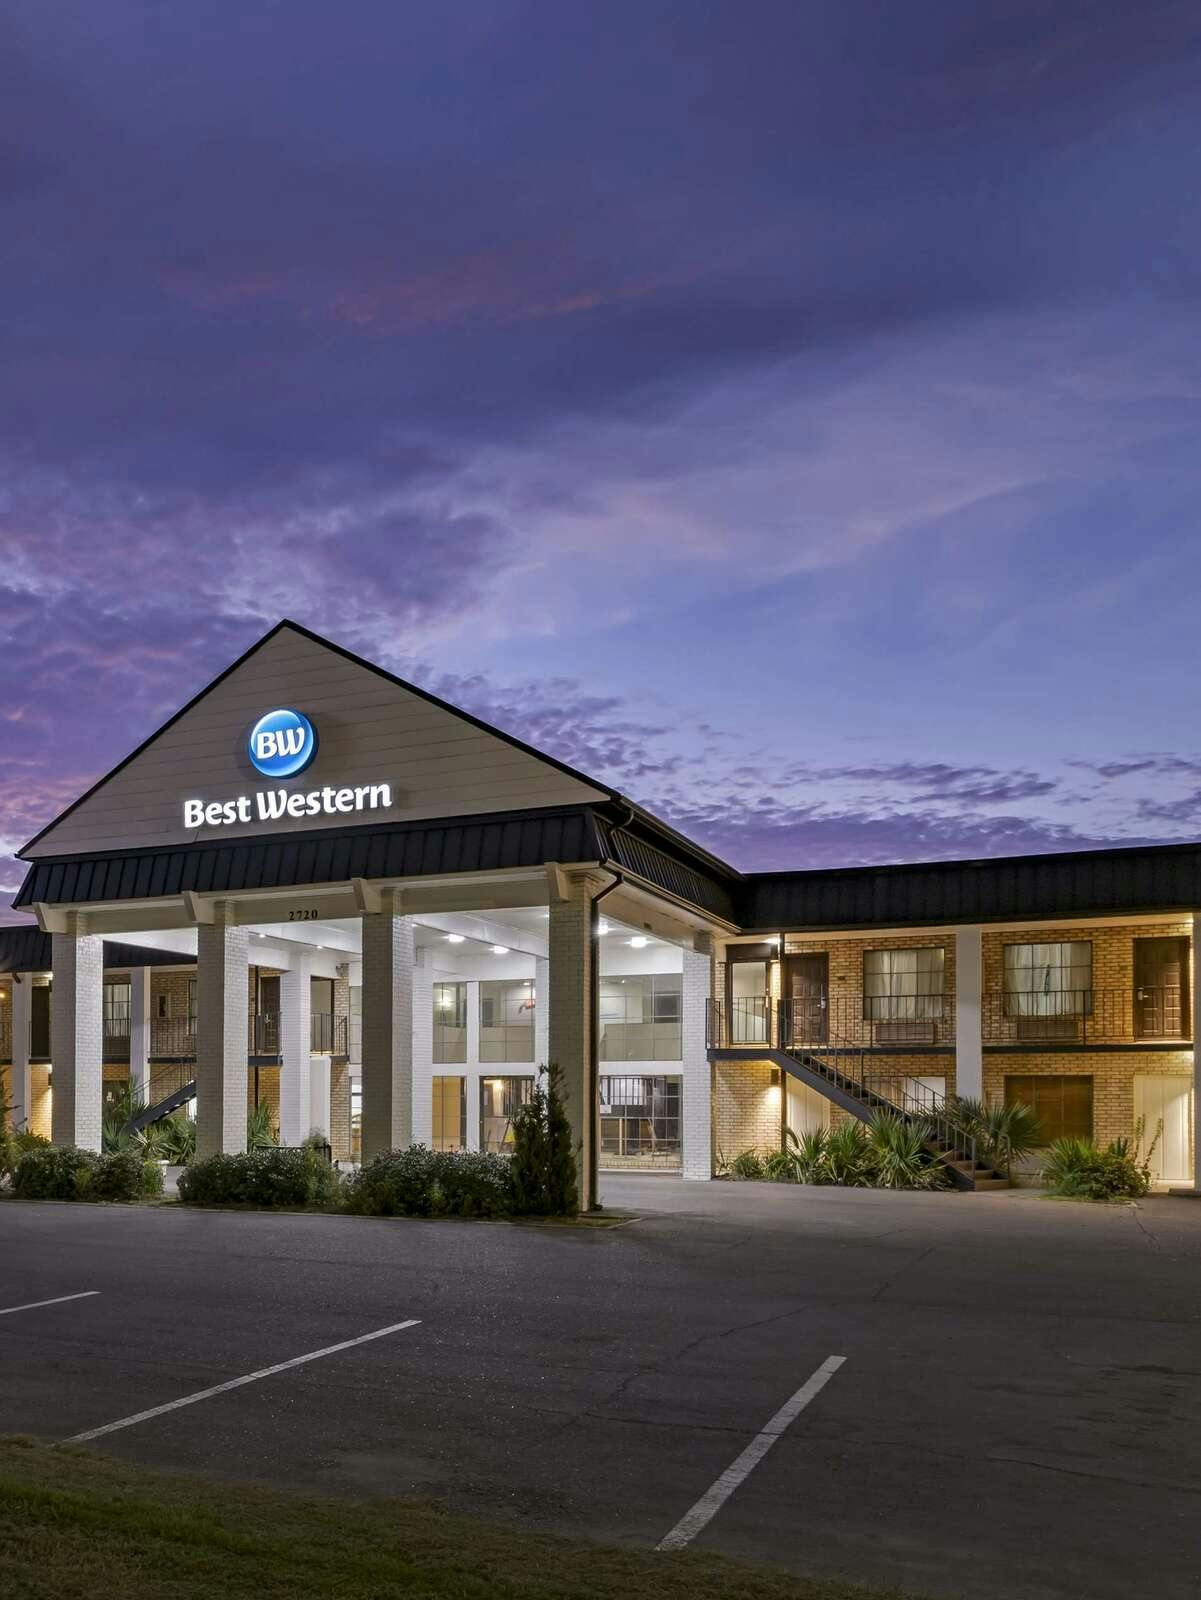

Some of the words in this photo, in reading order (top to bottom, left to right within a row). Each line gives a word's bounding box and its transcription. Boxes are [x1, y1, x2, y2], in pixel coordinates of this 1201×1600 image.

[255, 726, 305, 760] BW
[183, 796, 251, 829] Best
[256, 783, 393, 821] Western
[288, 909, 319, 921] 2720
